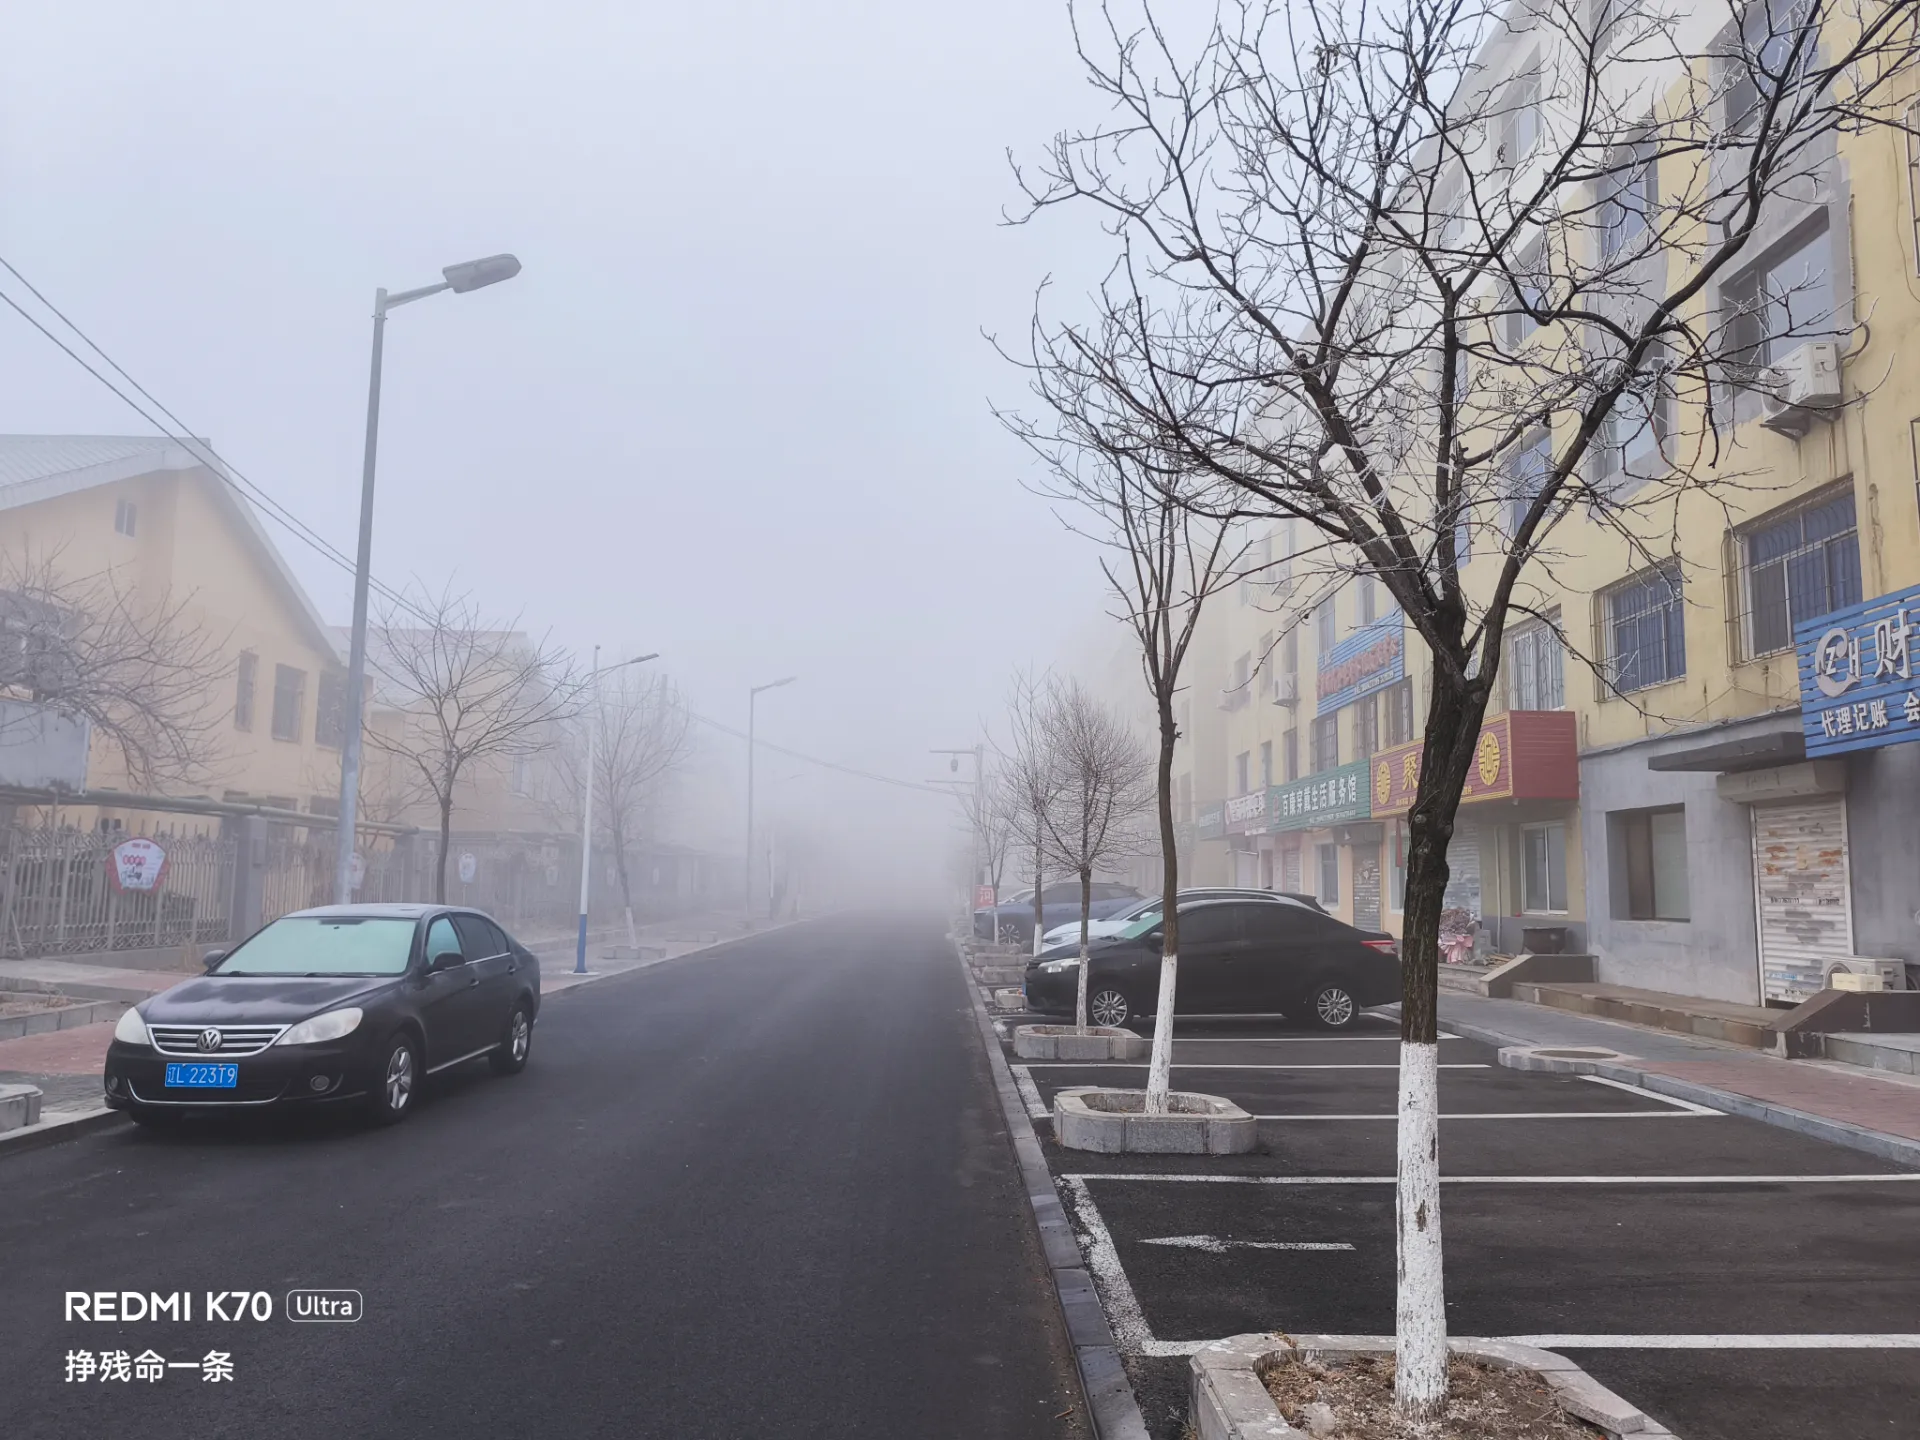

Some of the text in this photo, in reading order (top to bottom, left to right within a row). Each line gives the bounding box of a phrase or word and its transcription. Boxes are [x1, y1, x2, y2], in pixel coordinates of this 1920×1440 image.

[1873, 608, 1913, 679] 财
[1821, 699, 1889, 738] 代理记账
[1402, 751, 1419, 791] 聚
